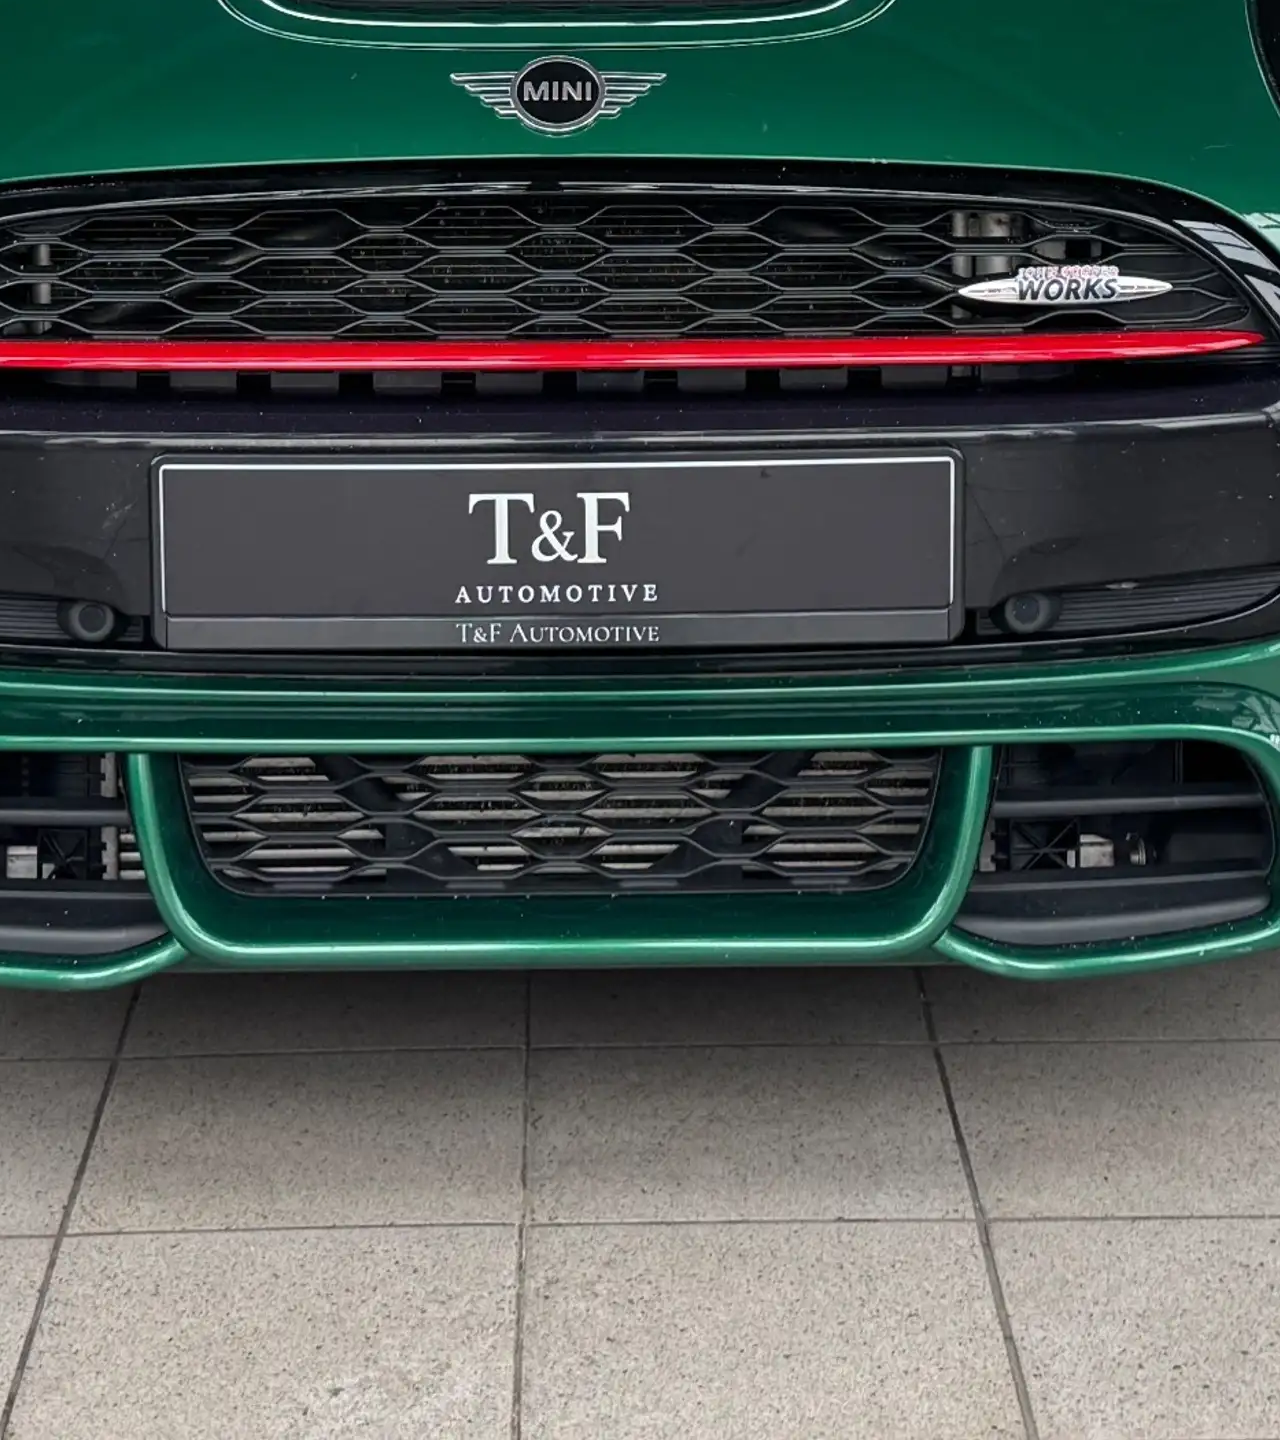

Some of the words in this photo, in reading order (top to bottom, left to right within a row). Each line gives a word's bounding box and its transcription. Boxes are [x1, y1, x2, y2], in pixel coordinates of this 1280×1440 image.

[523, 80, 592, 102] MINI
[1018, 278, 1119, 301] WORKS
[468, 492, 630, 564] T&F
[454, 584, 659, 605] AUTOMOTIVE
[456, 622, 502, 644] T&F
